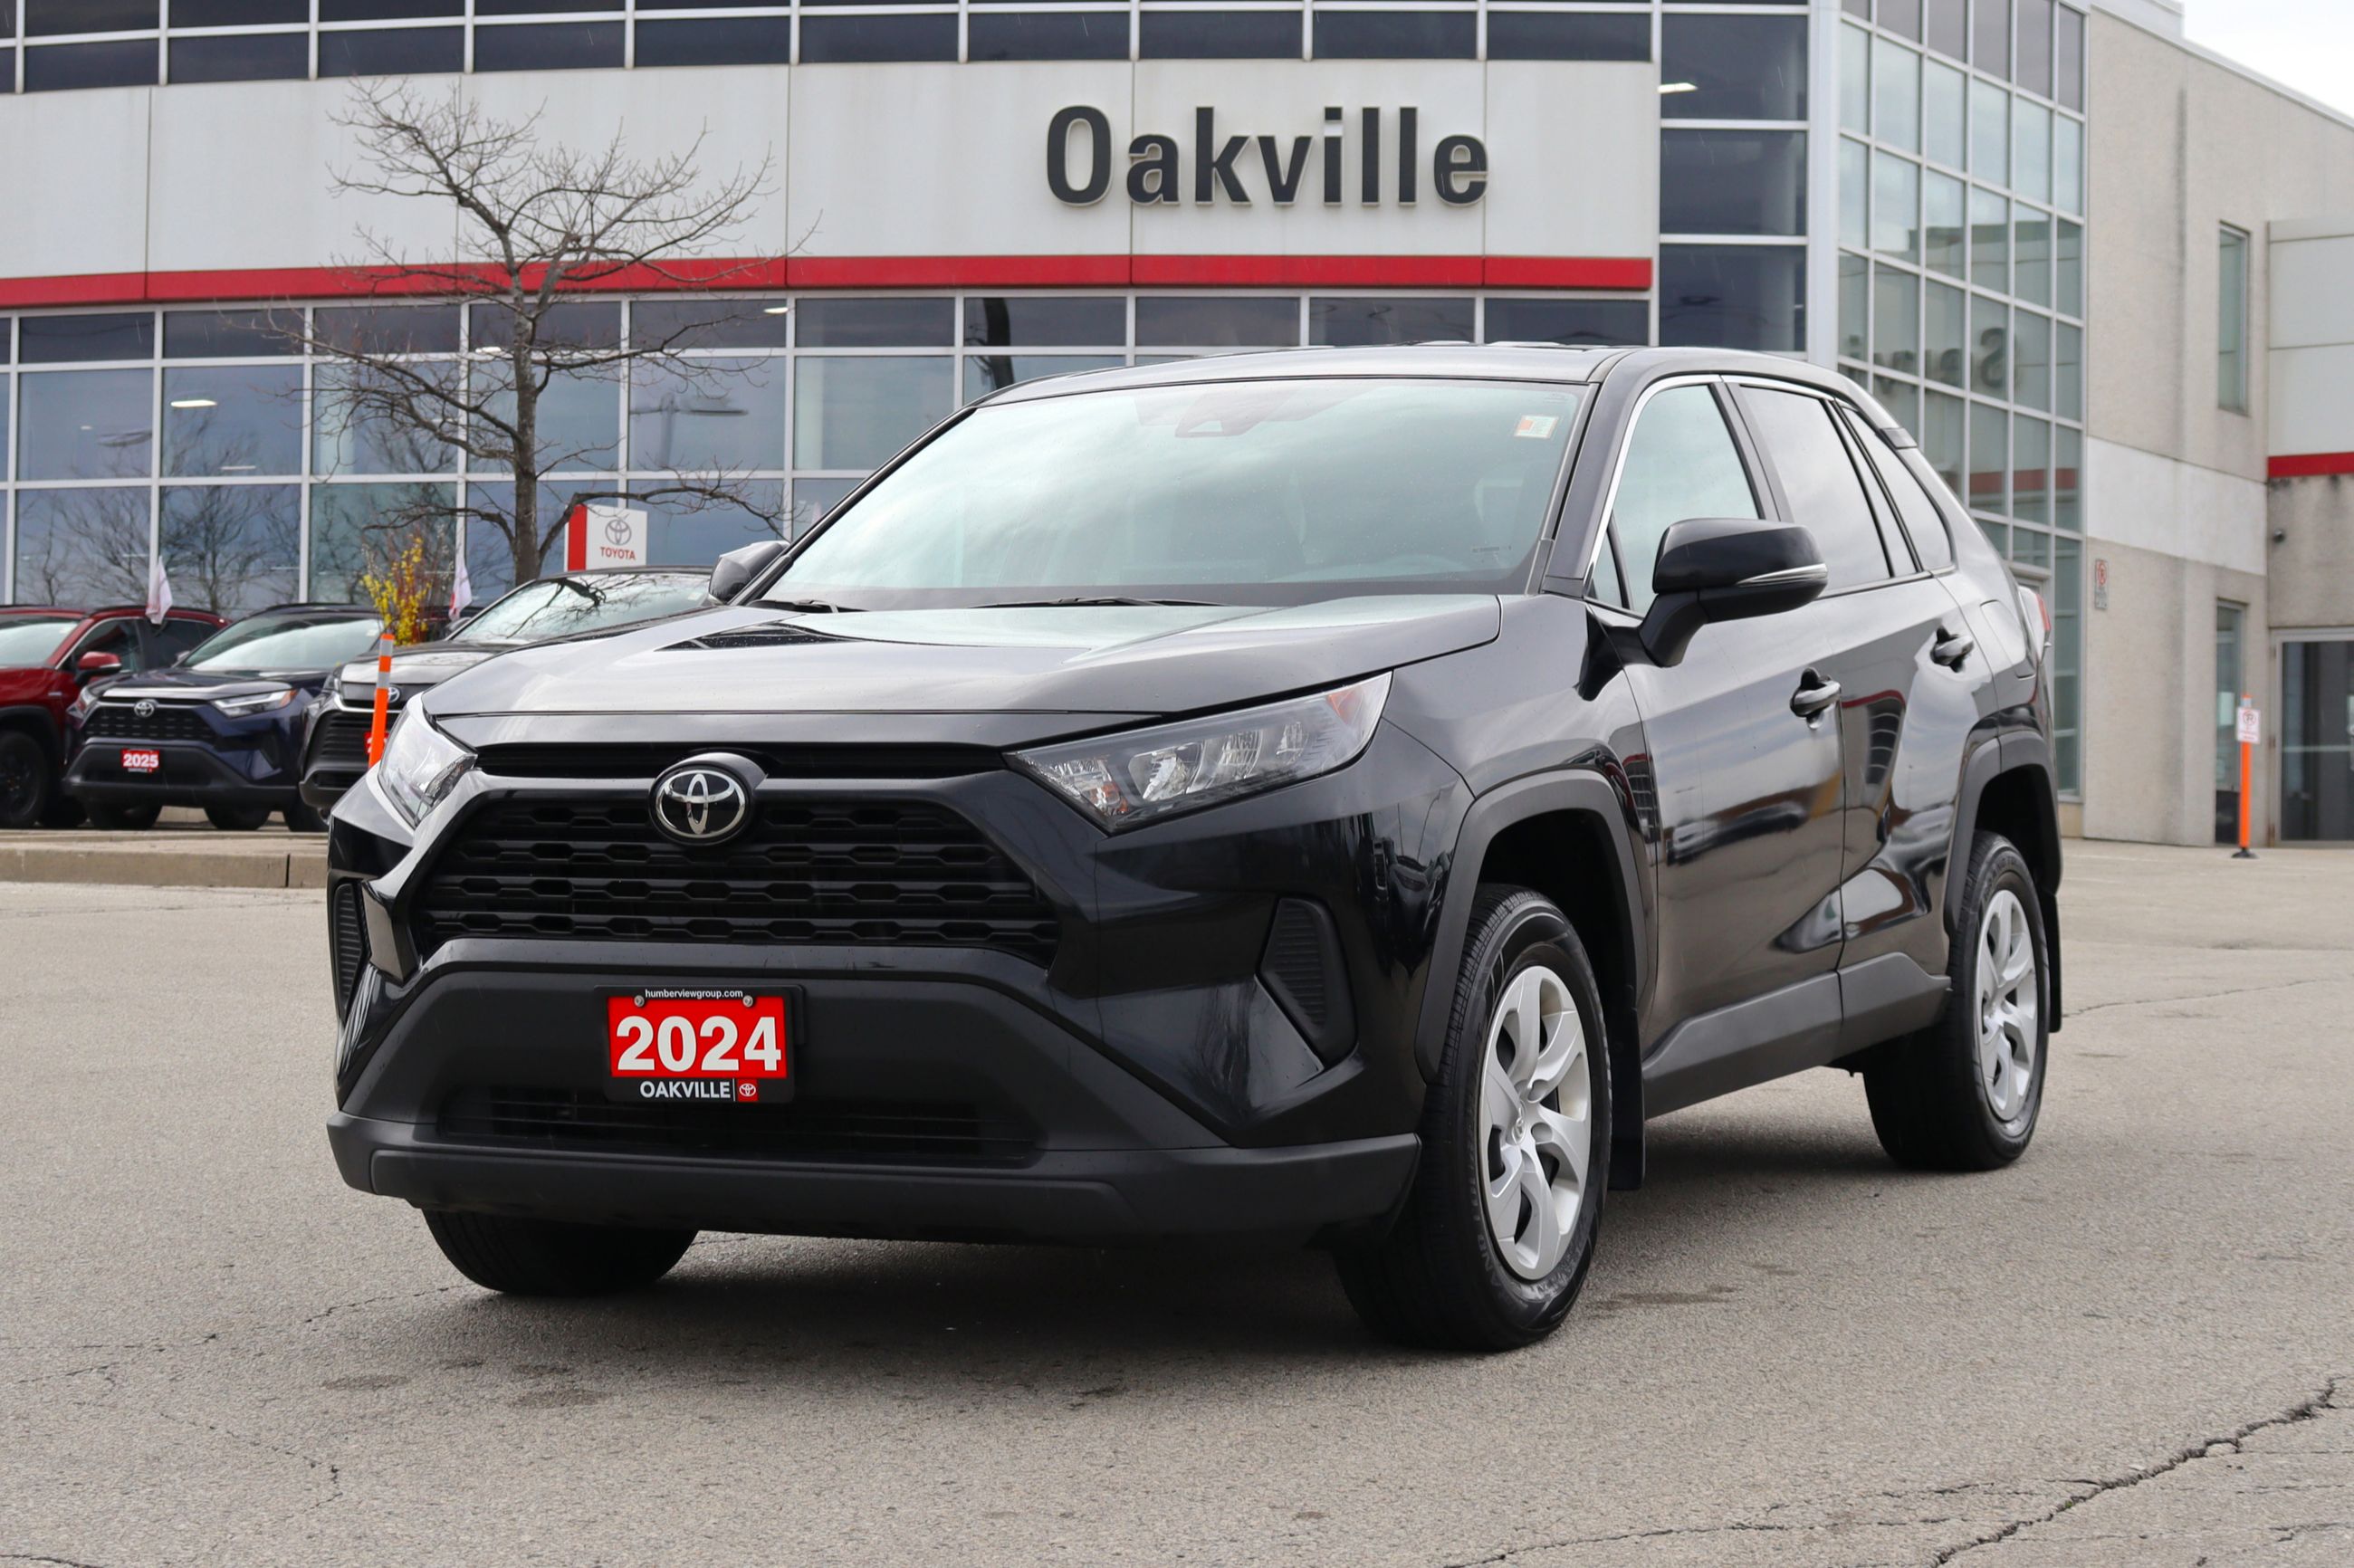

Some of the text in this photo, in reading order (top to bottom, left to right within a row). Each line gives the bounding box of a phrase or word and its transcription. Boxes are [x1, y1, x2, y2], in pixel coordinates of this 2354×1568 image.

[1047, 105, 1489, 206] Oakville
[600, 547, 636, 560] TOYOTA
[123, 753, 159, 768] 2025
[645, 989, 743, 999] humberviewgroup.com
[616, 1015, 781, 1072] 2024
[639, 1081, 731, 1098] OAKVILLE
